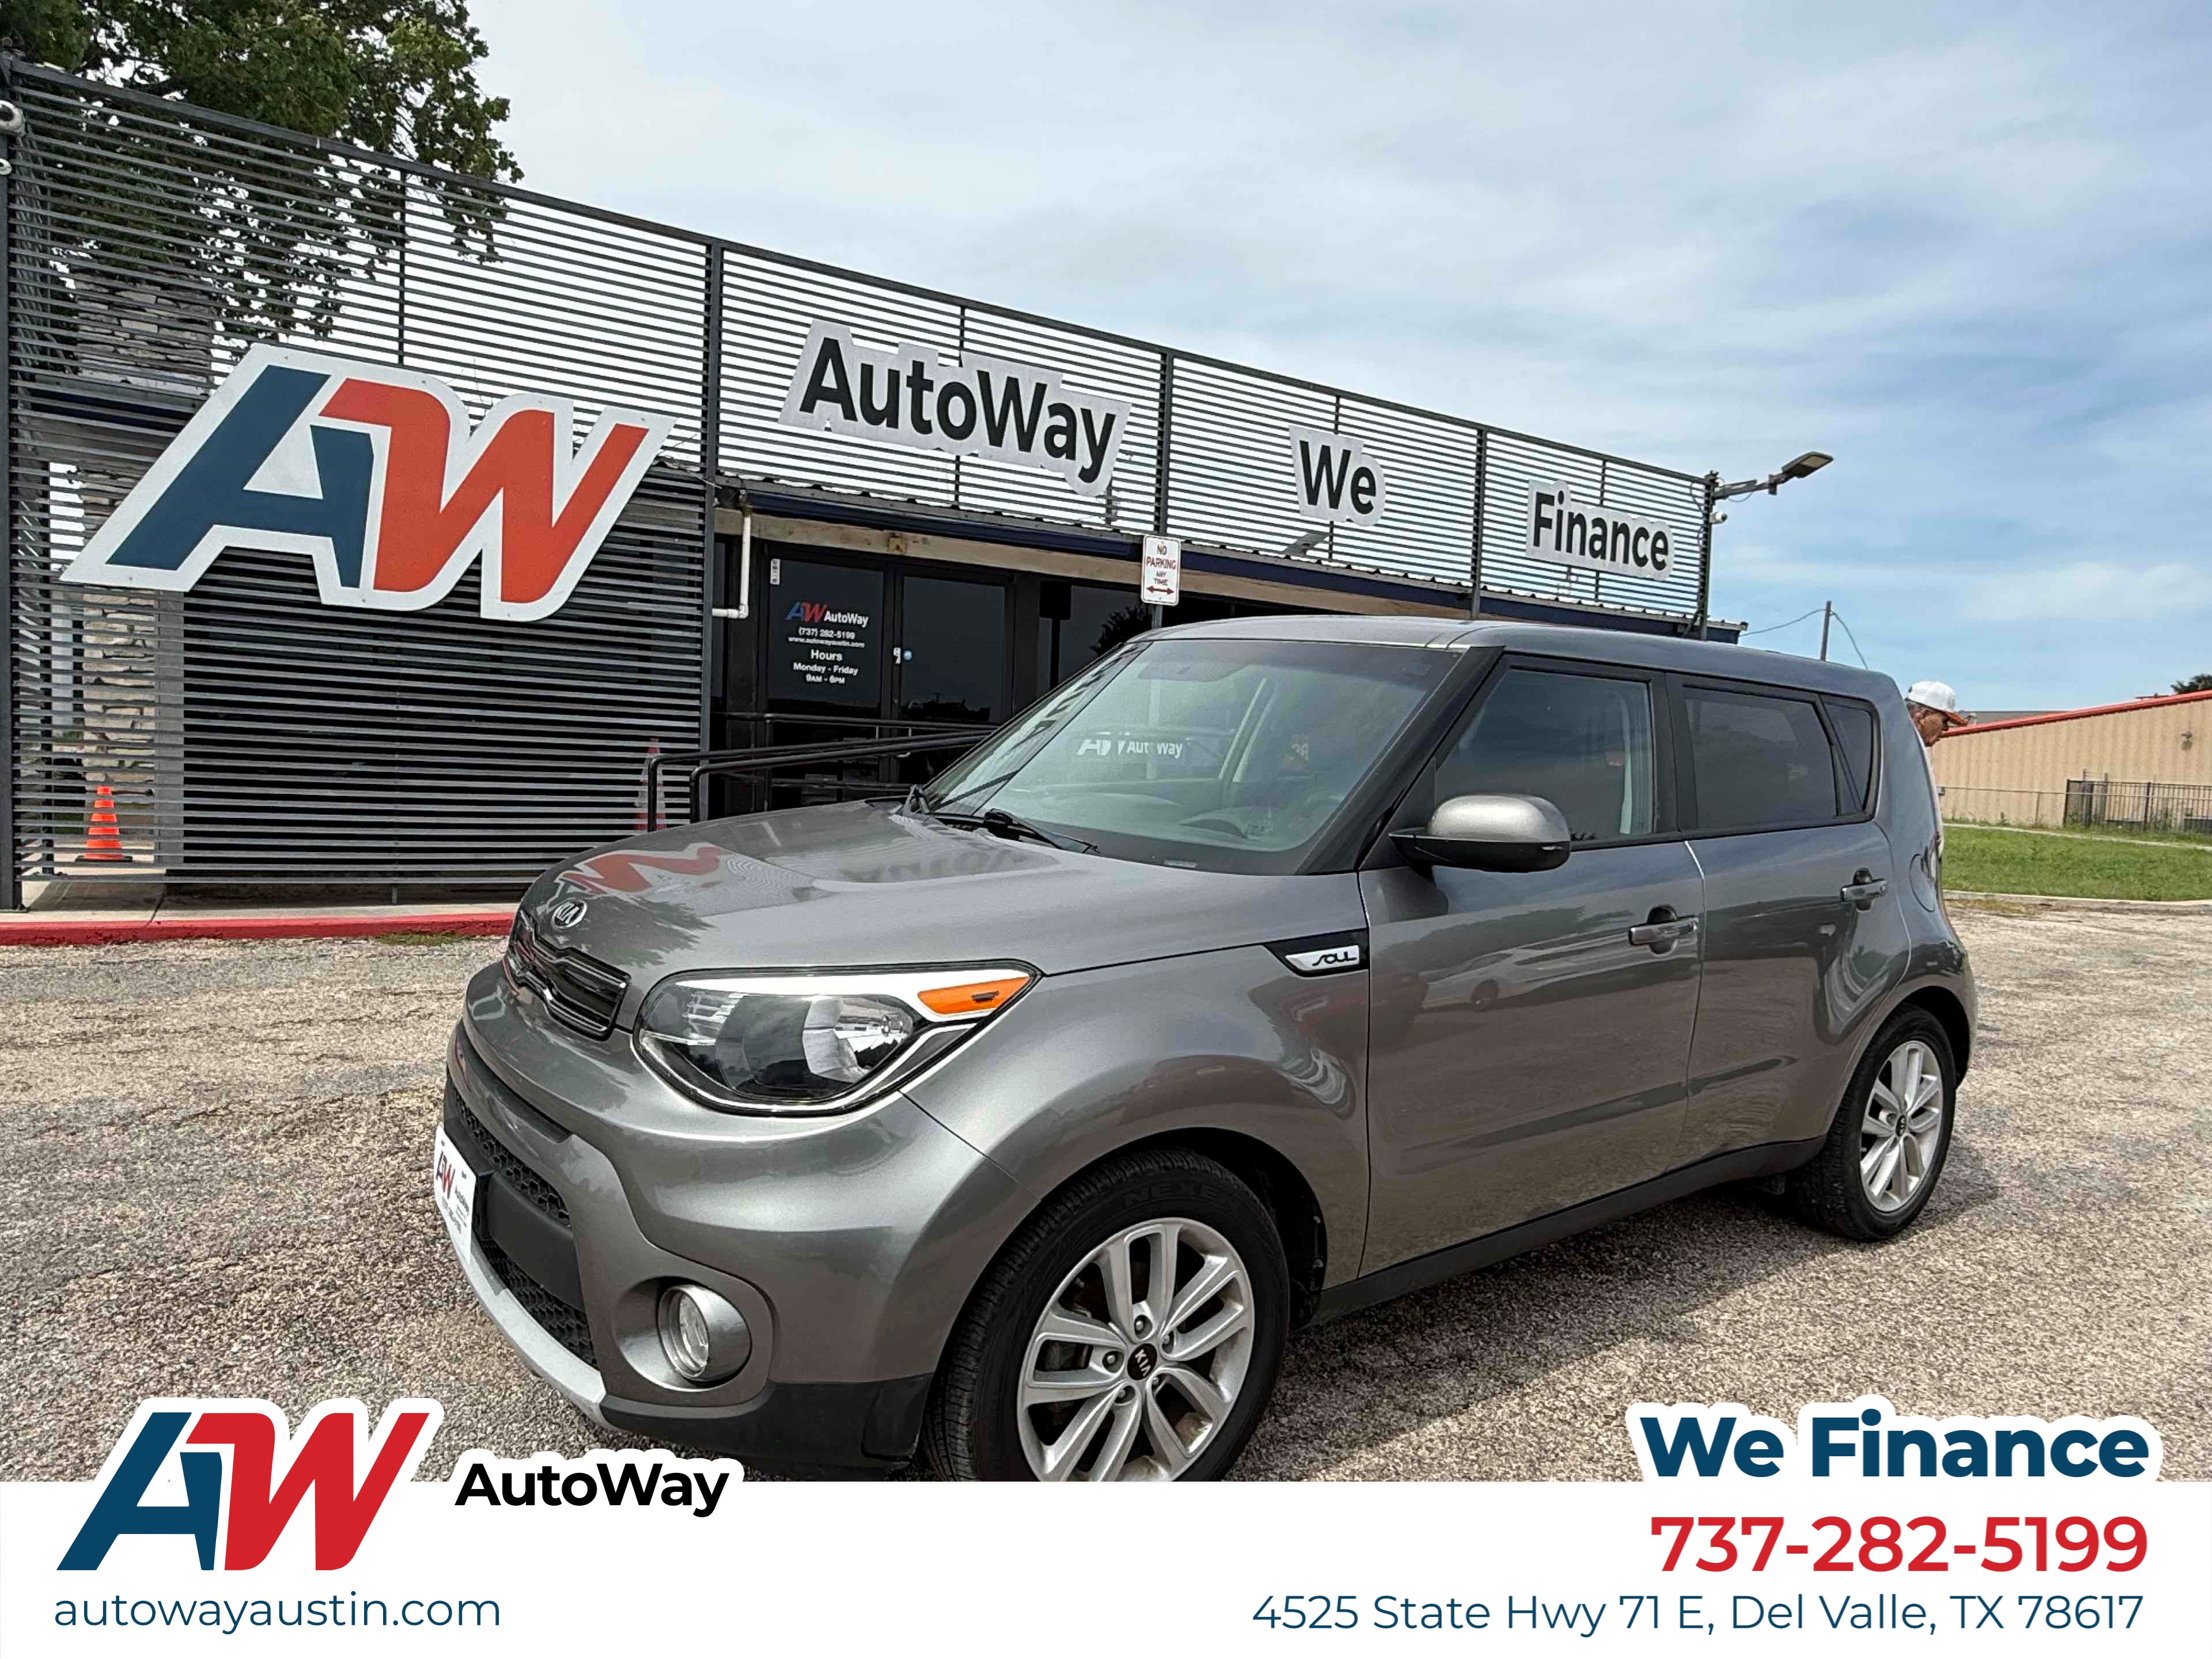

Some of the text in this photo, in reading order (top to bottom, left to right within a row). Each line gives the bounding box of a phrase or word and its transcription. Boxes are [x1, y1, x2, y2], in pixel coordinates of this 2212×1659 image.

[800, 337, 1116, 484] AutoWay
[107, 364, 649, 604] AW
[1299, 440, 1377, 515] We
[1533, 490, 1669, 571] Finance
[1157, 544, 1168, 556] NO
[1146, 556, 1176, 570] PARKING
[1154, 578, 1169, 586] TIME
[785, 601, 868, 627] AW AutoWay
[798, 627, 855, 639] (737) 282-5199
[810, 649, 843, 661] Hours
[793, 662, 826, 674] Monday
[833, 665, 858, 676] Friday
[1312, 951, 1357, 967] SOUL
[1135, 1349, 1151, 1376] KIA
